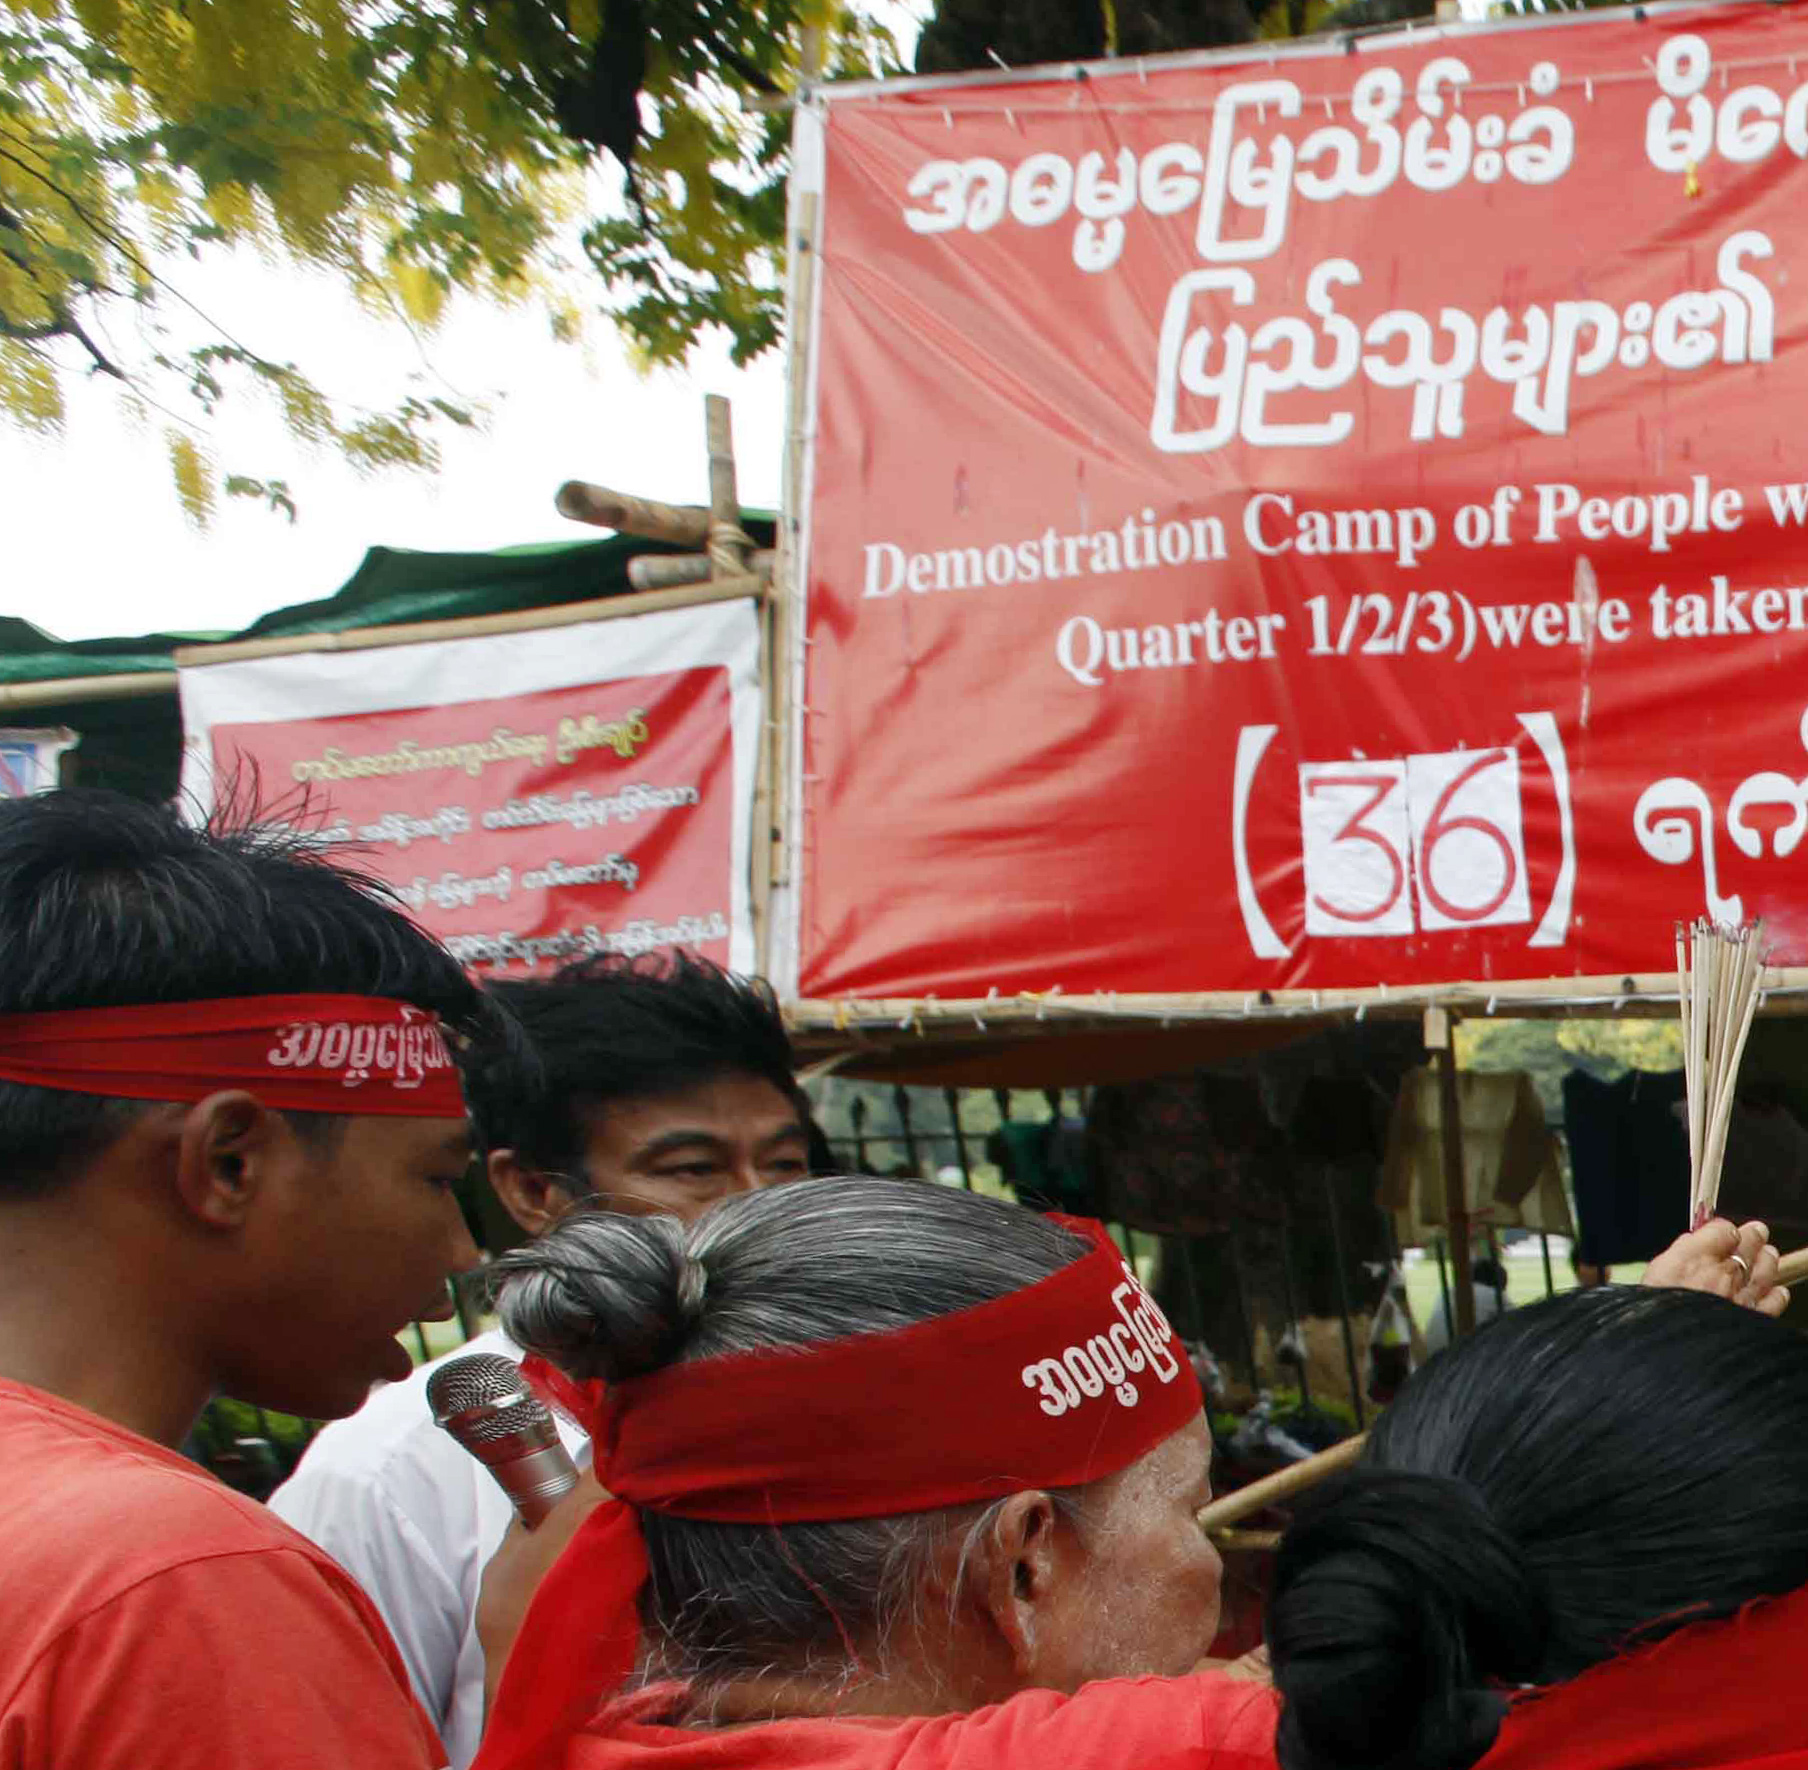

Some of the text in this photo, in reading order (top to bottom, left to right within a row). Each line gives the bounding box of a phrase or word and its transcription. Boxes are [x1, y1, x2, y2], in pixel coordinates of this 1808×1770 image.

[1149, 230, 1775, 453] ပြည်သူများ၏
[862, 507, 1226, 599] Demostration
[1244, 493, 1435, 566] Camp
[1455, 489, 1520, 546] of
[1535, 477, 1743, 552] People
[1055, 609, 1286, 686] Quarter
